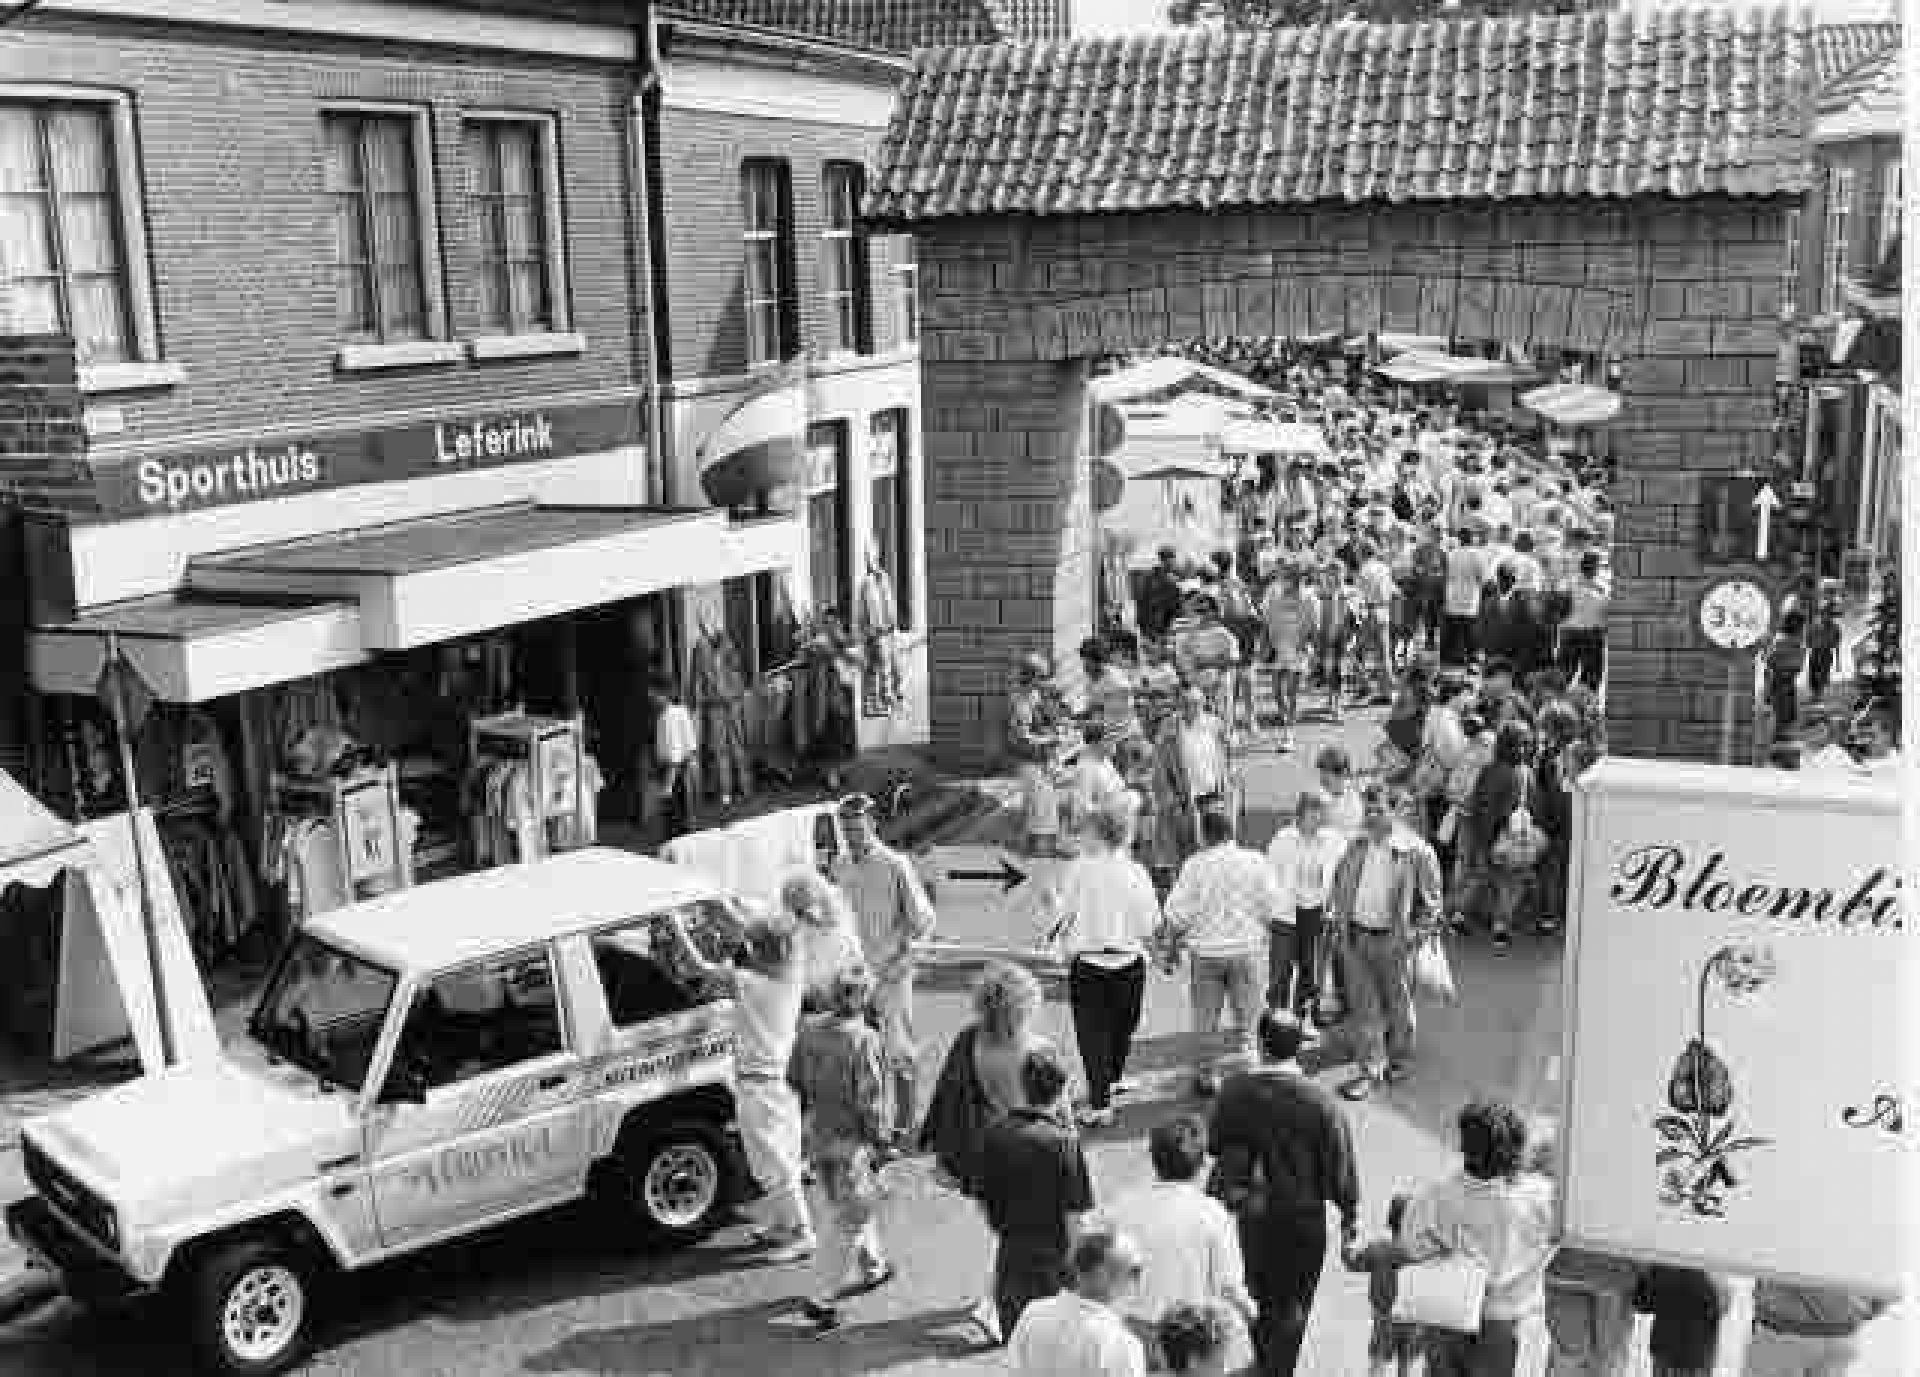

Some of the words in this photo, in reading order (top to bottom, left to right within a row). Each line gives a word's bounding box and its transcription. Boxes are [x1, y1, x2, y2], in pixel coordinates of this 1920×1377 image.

[138, 446, 317, 507] Sporthuis
[434, 414, 552, 462] Leferink
[1609, 845, 1903, 927] Bloembi
